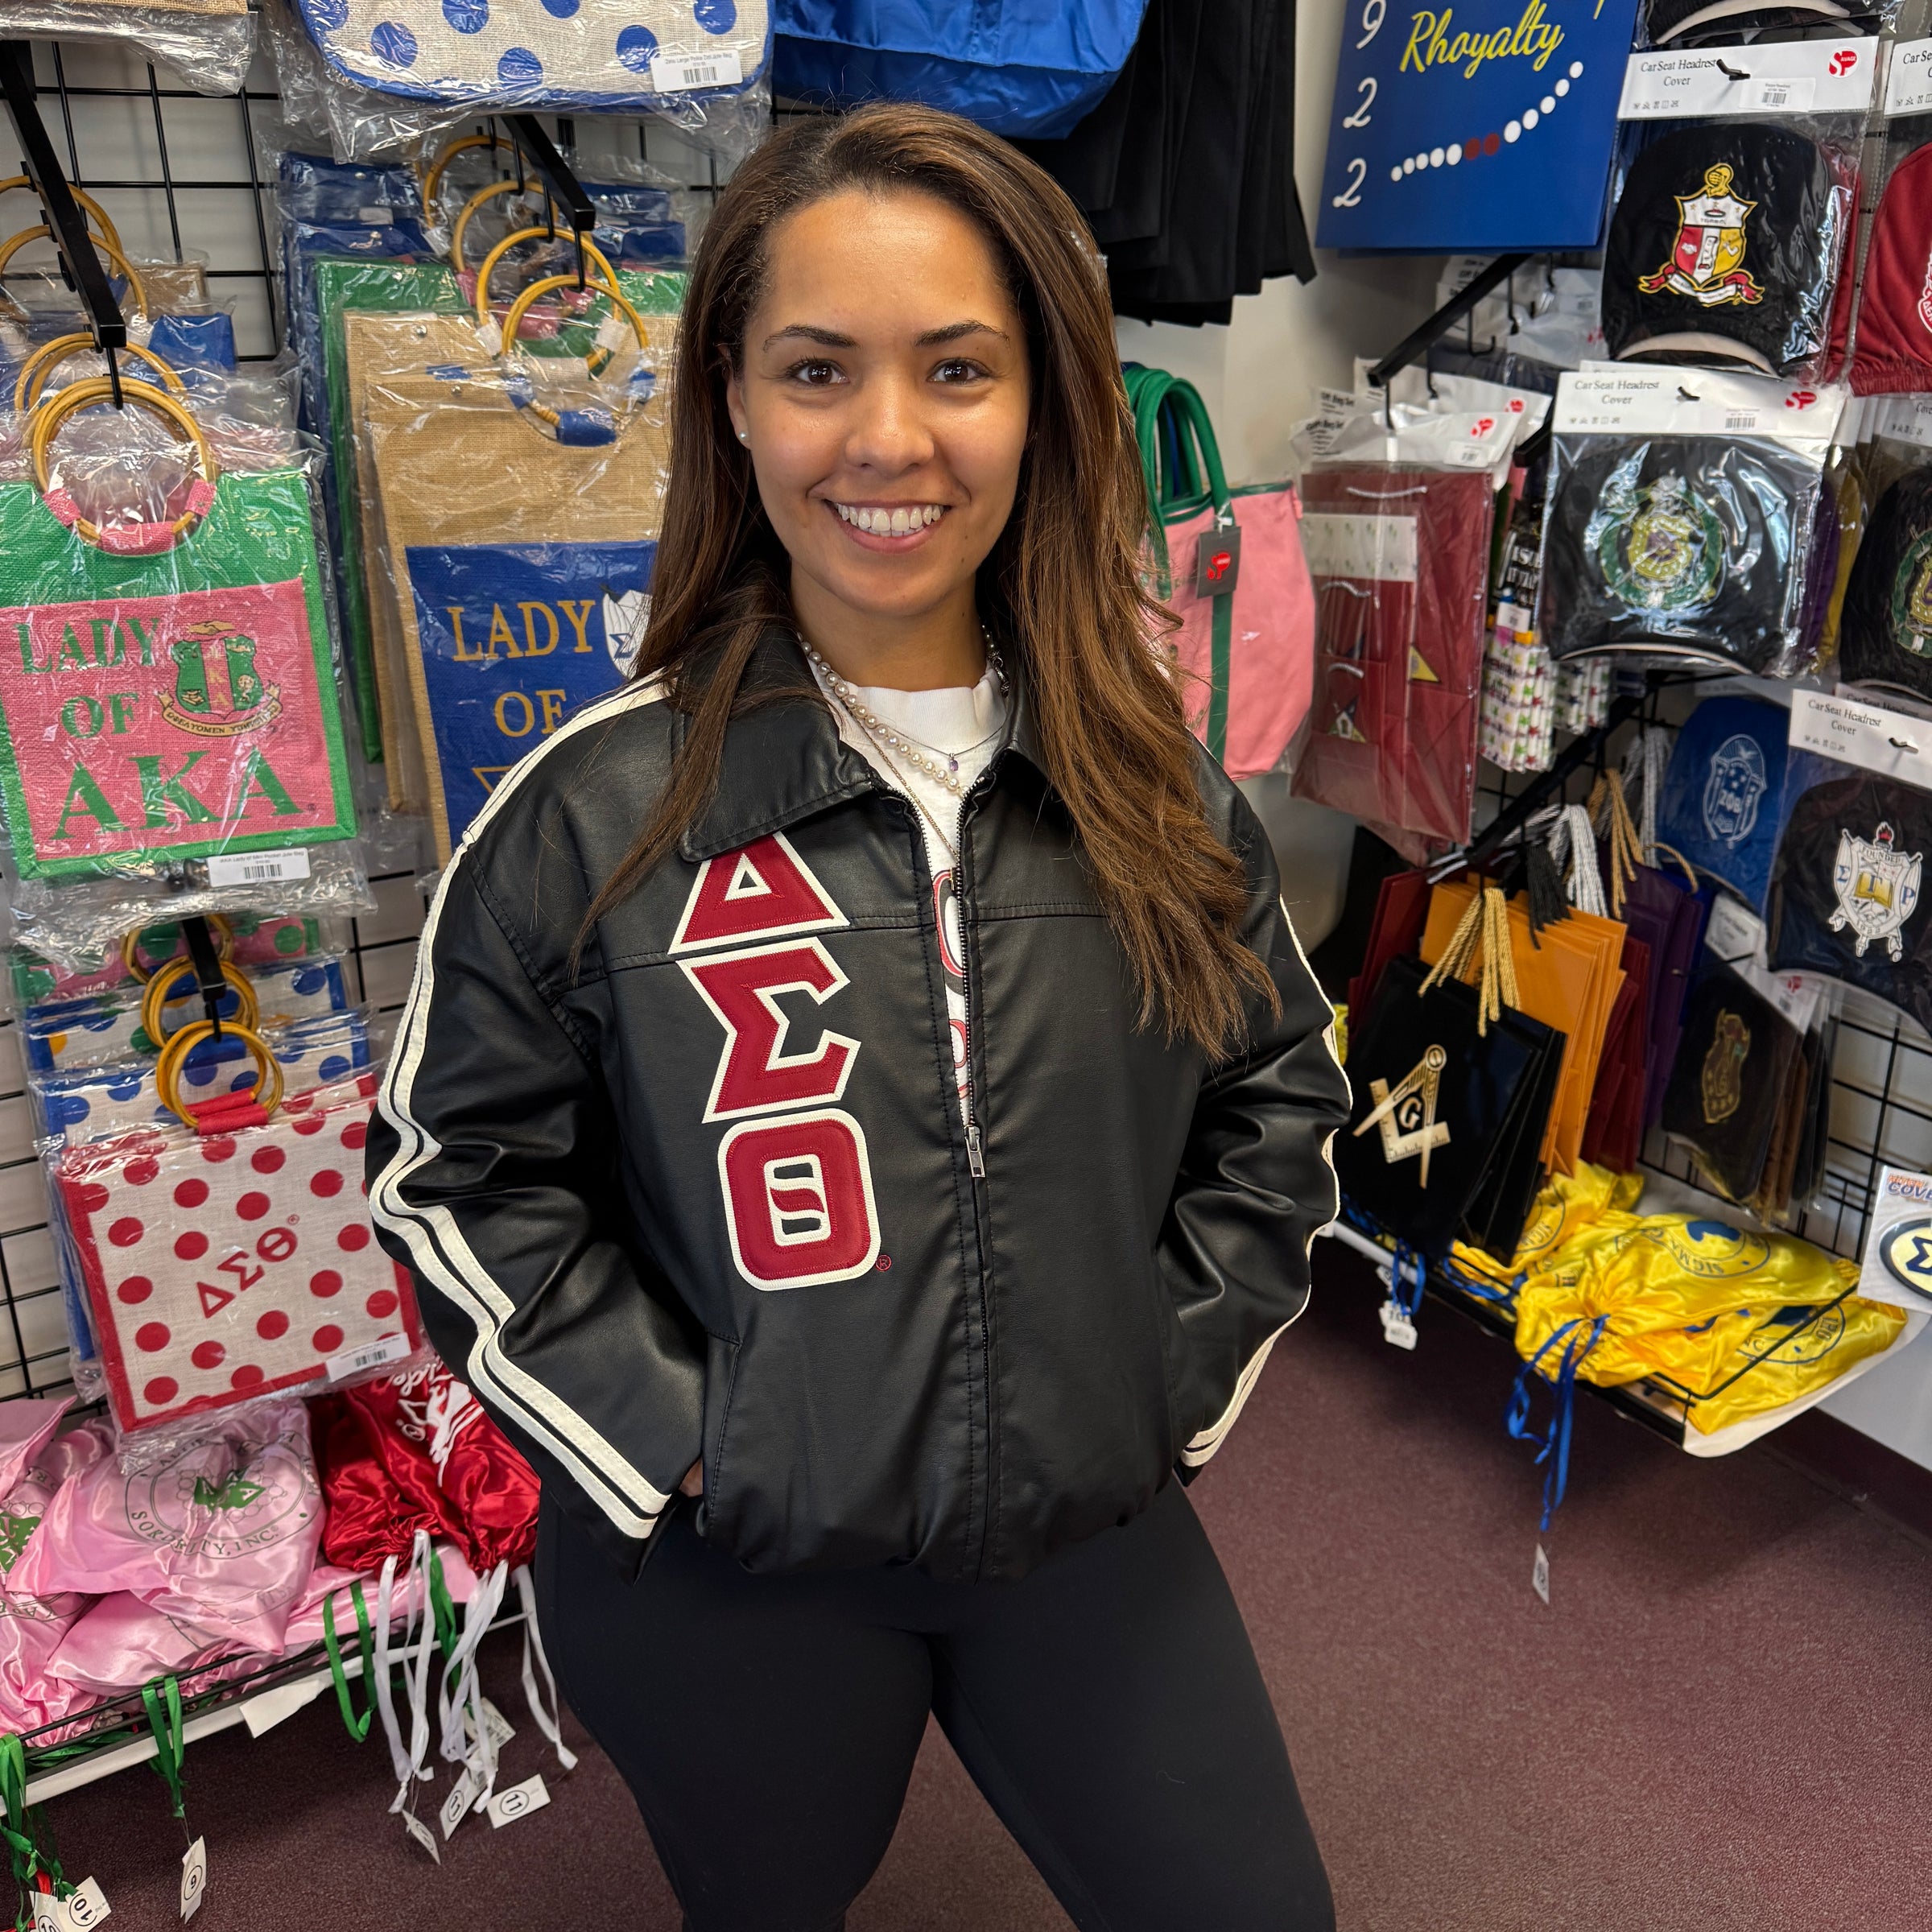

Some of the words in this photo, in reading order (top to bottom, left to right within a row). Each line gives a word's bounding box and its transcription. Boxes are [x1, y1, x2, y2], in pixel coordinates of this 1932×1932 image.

[1399, 0, 1565, 79] Rhoyalty
[1641, 62, 1656, 72] Car
[1657, 61, 1675, 71] Seat
[1678, 58, 1716, 69] Headrest
[1903, 52, 1920, 64] Car
[1663, 76, 1691, 86] Cover
[1575, 380, 1592, 390] Car
[1594, 380, 1614, 390] Seat
[1617, 380, 1659, 390] Headrest
[1601, 394, 1633, 404] Cover
[447, 600, 596, 661] LADY
[14, 618, 159, 675] LADY
[62, 692, 139, 739] OF
[493, 689, 567, 737] OF
[1808, 700, 1824, 712] Car
[1826, 704, 1842, 717] Seat
[1844, 708, 1881, 727] Headrest
[1831, 720, 1856, 737] Cover
[50, 749, 303, 840] AKA
[1399, 1096, 1422, 1129] G
[196, 1227, 298, 1319] ΔΣΘ
[234, 1530, 279, 1551] INC.
[74, 1897, 93, 1921] 10
